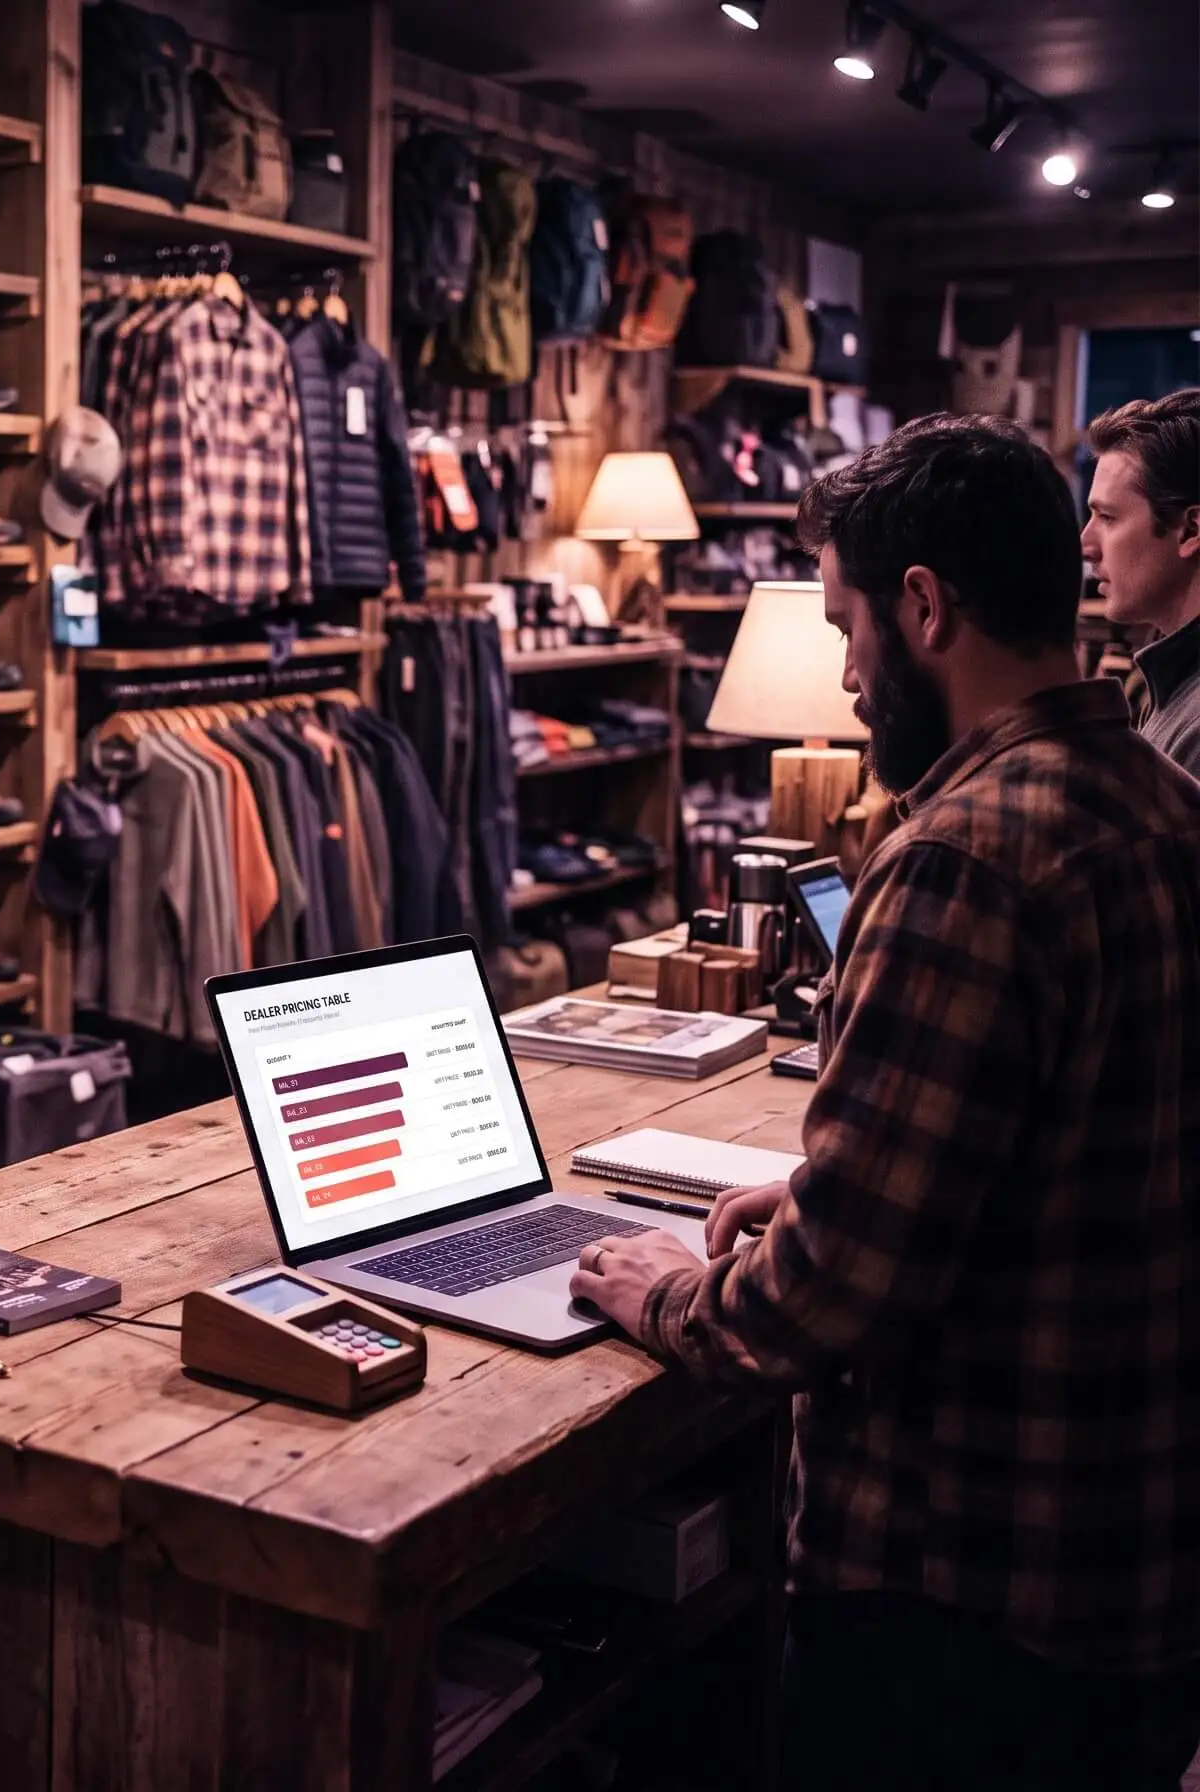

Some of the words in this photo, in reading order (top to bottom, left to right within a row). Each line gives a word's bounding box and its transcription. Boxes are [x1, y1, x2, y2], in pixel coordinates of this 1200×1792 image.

[243, 1005, 281, 1022] DEALER
[282, 998, 321, 1016] PRICING
[321, 992, 351, 1007] TABLE
